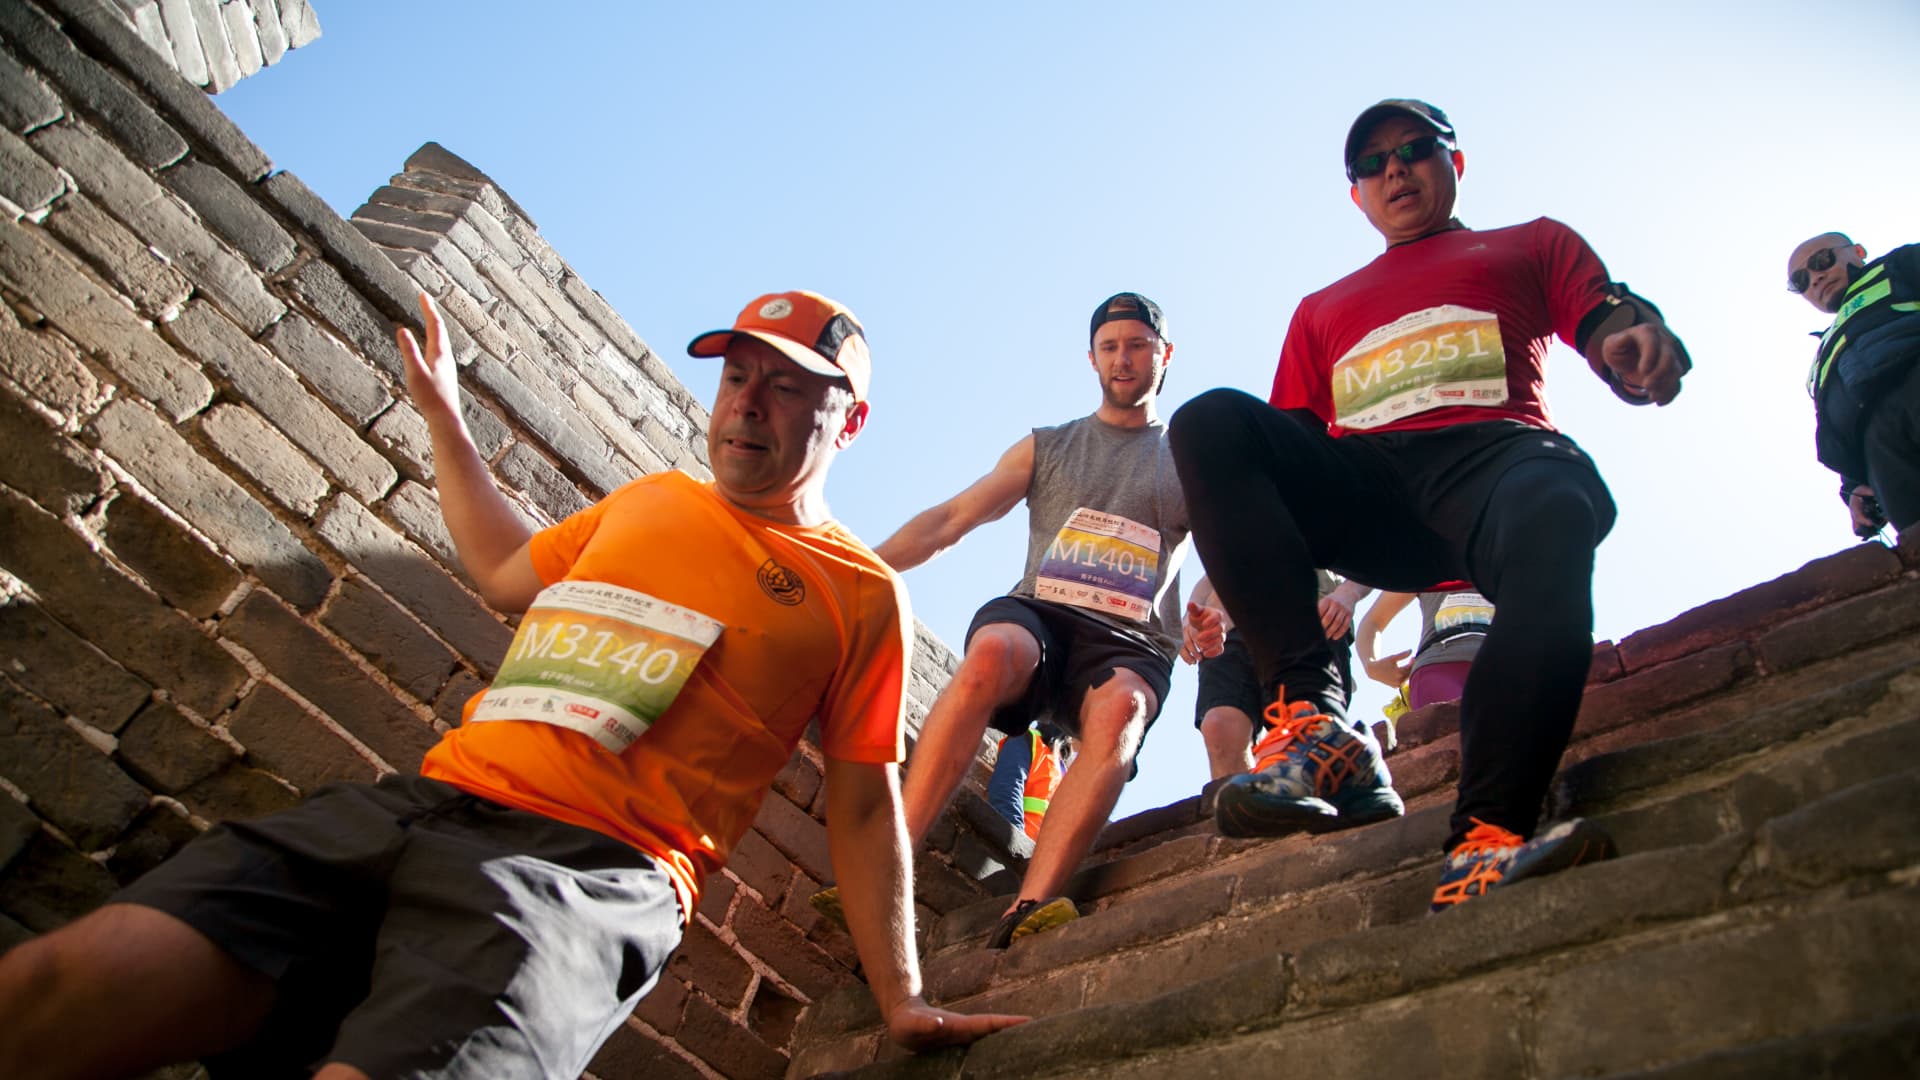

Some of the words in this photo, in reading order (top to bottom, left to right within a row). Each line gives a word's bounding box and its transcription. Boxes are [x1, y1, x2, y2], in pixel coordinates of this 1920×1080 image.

[1344, 328, 1489, 394] M3251
[1051, 537, 1148, 582] M1401
[515, 622, 679, 684] M3140
